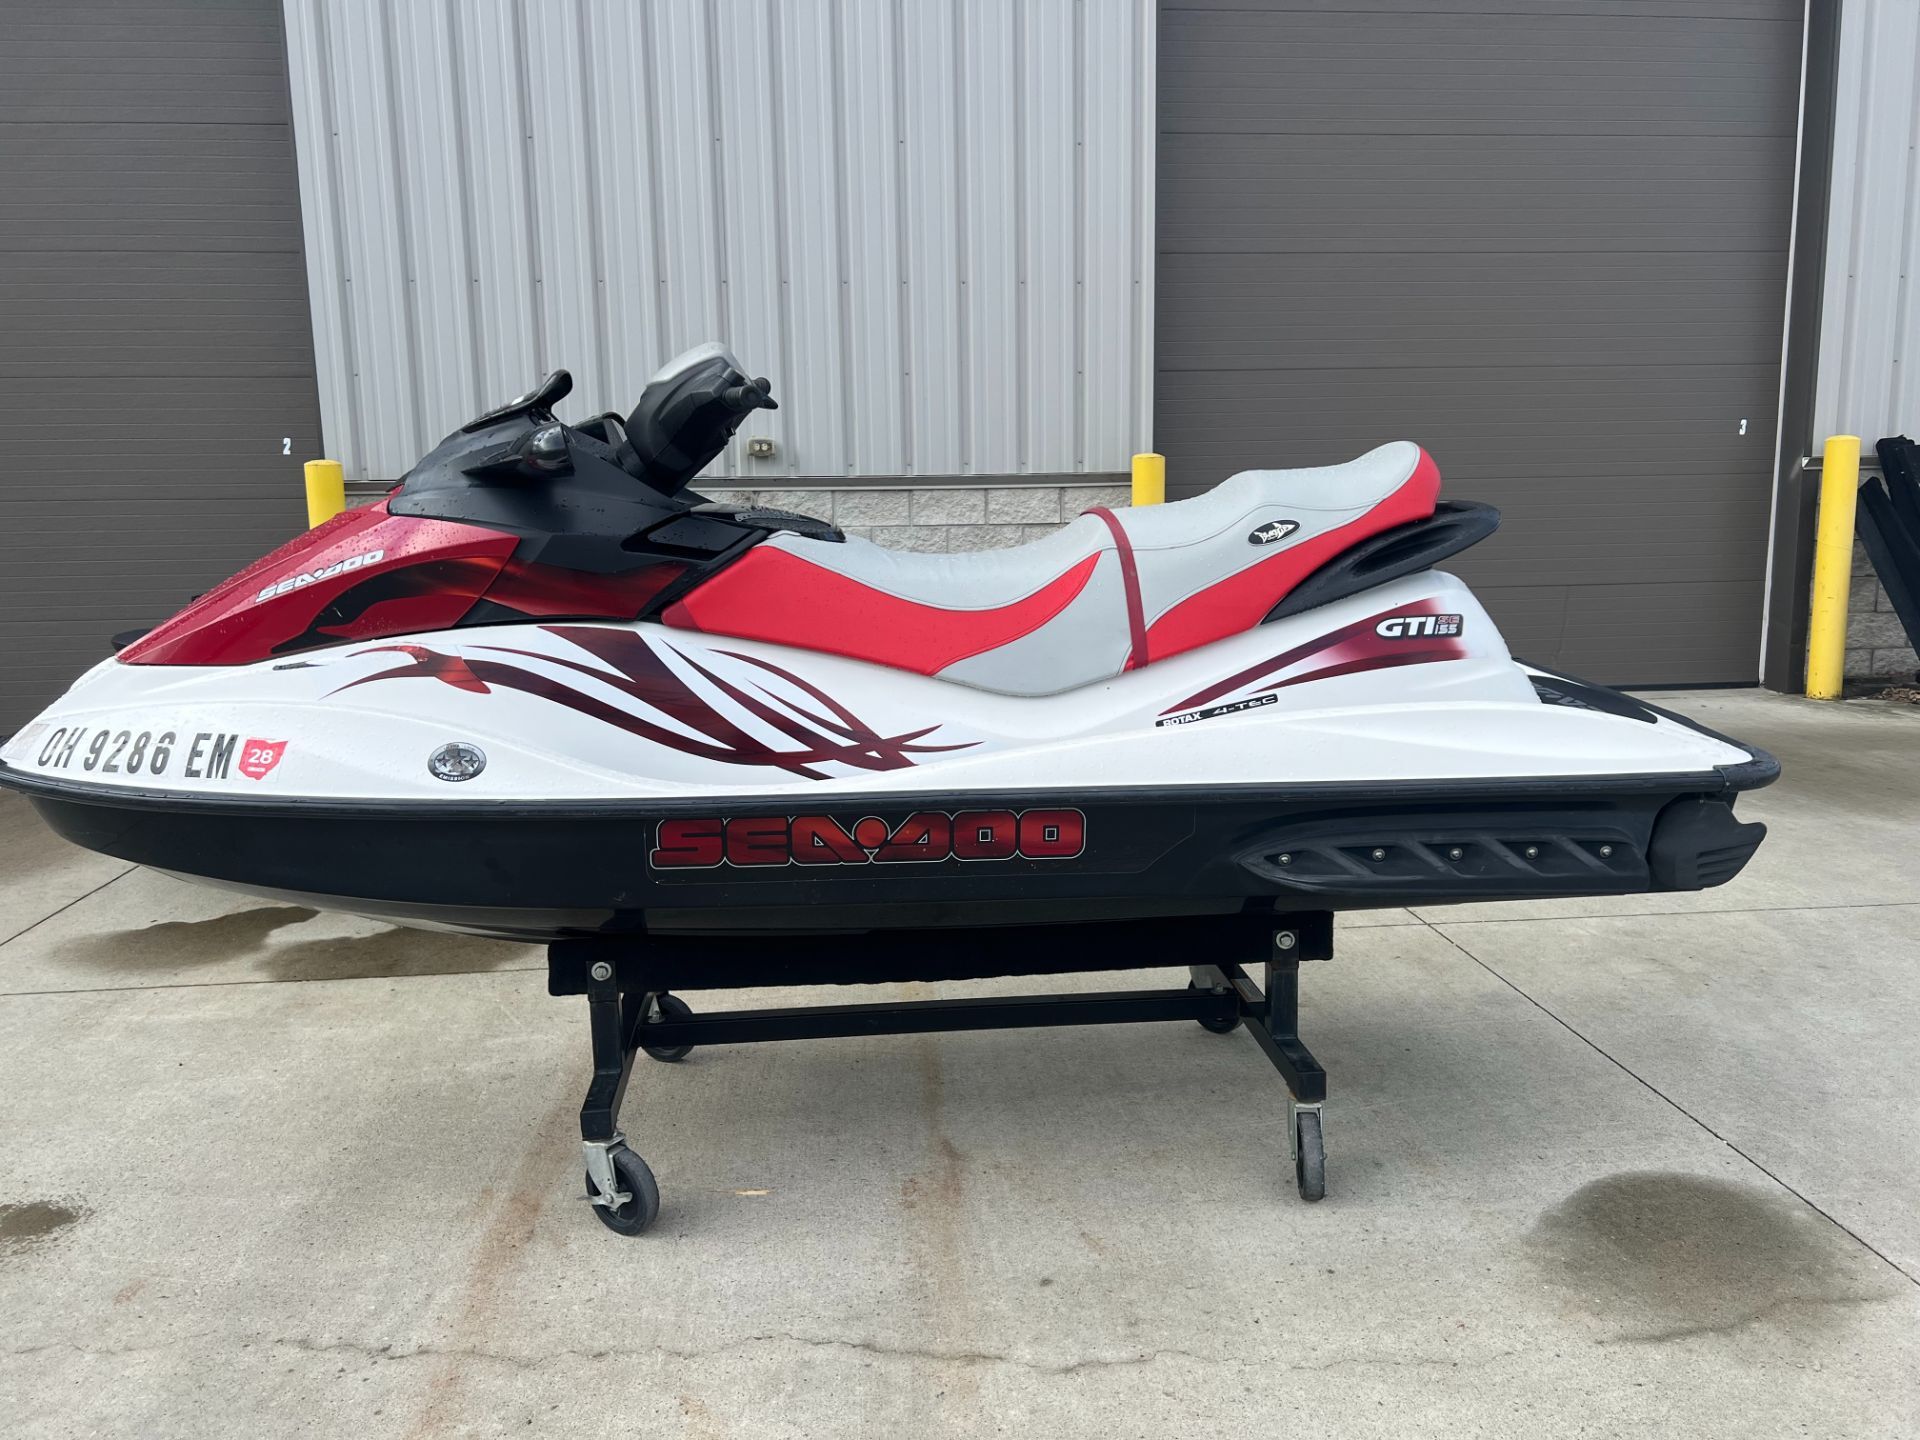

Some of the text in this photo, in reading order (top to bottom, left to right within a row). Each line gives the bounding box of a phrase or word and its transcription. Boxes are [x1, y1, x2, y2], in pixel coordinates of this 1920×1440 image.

[1739, 419, 1747, 435] 3
[283, 437, 291, 455] 2
[1376, 616, 1436, 637] GTI
[1163, 696, 1276, 726] ROTAX 4-TEC
[38, 727, 239, 779] OH 9286 EM
[248, 748, 273, 764] 28
